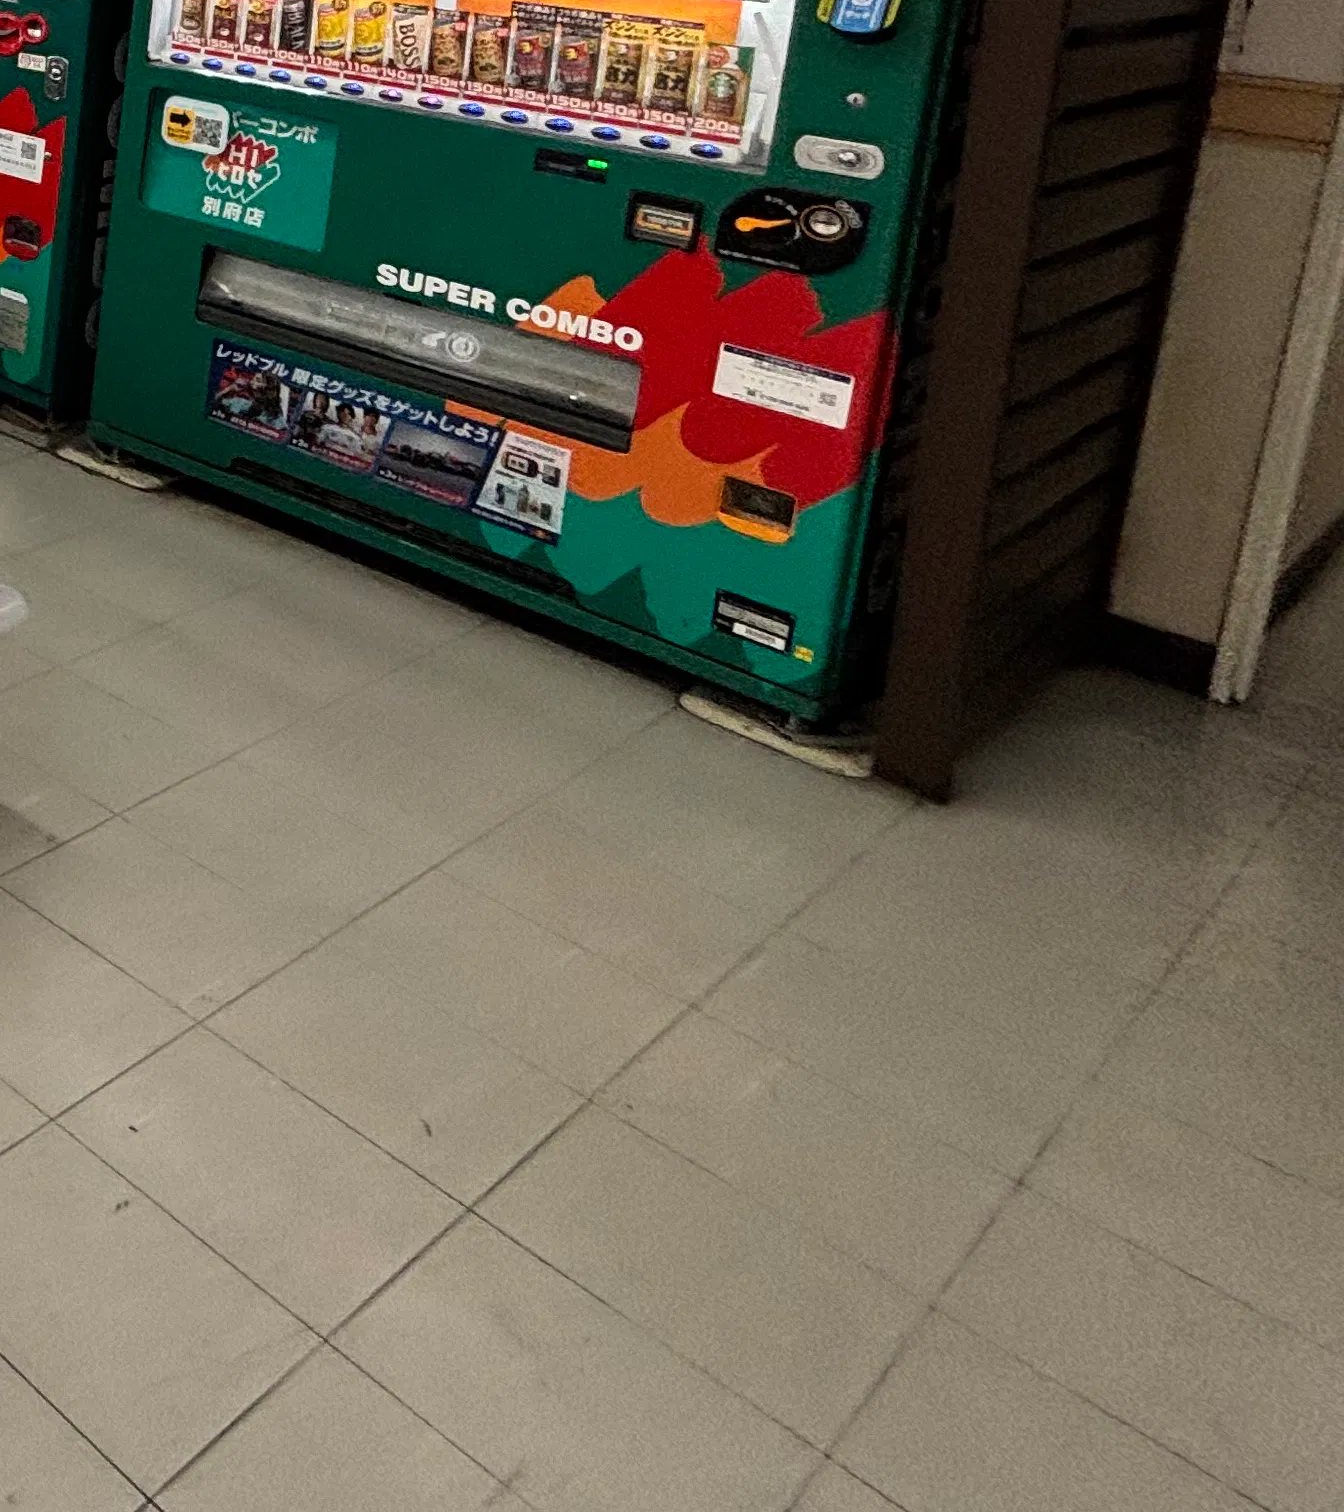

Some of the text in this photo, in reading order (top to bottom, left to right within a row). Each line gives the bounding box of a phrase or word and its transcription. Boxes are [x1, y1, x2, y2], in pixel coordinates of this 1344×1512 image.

[398, 22, 422, 69] BOSS
[228, 144, 261, 168] HI
[376, 263, 645, 353] SUPER COMBO
